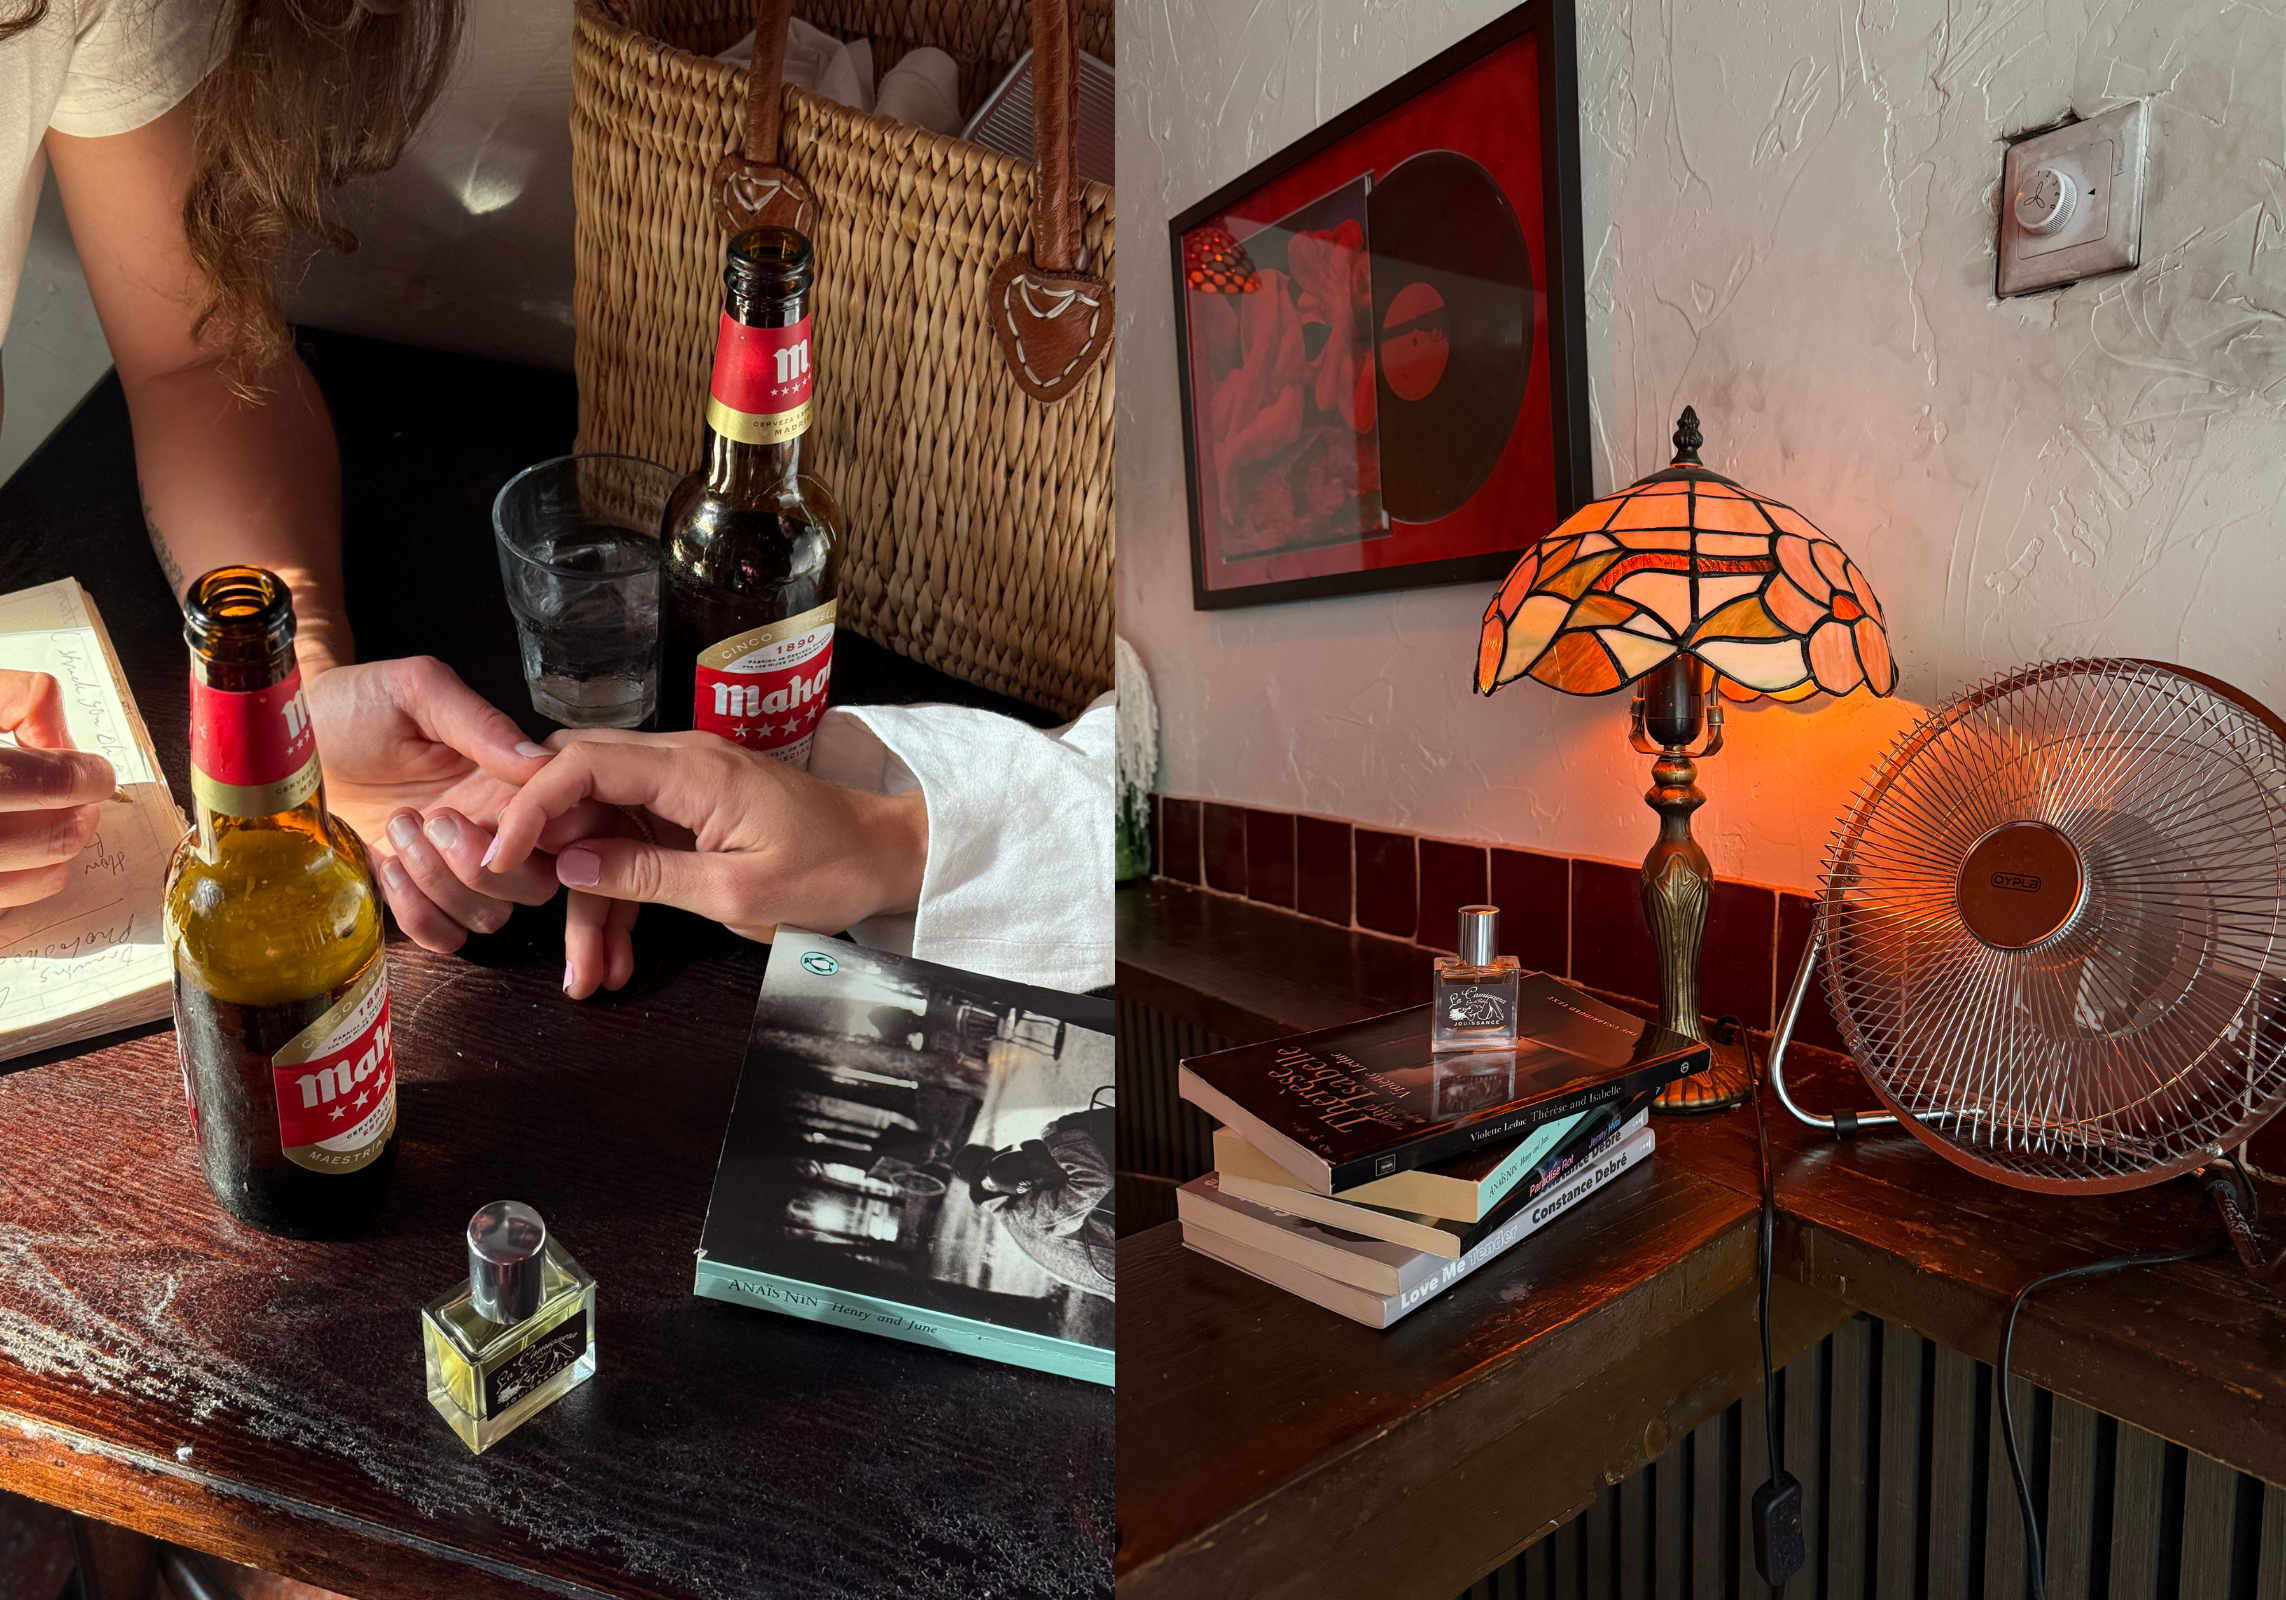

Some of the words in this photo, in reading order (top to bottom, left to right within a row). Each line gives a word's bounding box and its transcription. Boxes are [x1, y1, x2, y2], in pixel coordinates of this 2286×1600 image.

[753, 417, 794, 428] CERVEZA
[722, 633, 772, 660] CINCO
[776, 634, 815, 655] 1890
[1546, 996, 1569, 1008] TEXT
[302, 1001, 353, 1049] CINCO
[1454, 1019, 1500, 1027] JOUISSANCE
[1274, 1046, 1379, 1102] Isabelle
[1330, 1052, 1368, 1074] Leduc
[1268, 1067, 1376, 1134] Thérèse
[1365, 1072, 1412, 1099] Violette
[346, 1108, 382, 1140] CERVEZA
[1470, 1126, 1502, 1143] Violette
[1503, 1117, 1527, 1131] Leduc
[1530, 1103, 1568, 1122] Thérèse
[1569, 1094, 1587, 1110] and
[1588, 1084, 1622, 1103] Isabelle
[1529, 1166, 1561, 1198] Paradise
[1561, 1153, 1575, 1172] Rot
[1588, 1128, 1608, 1150] Jenny
[1608, 1115, 1622, 1134] Hval
[1400, 1276, 1439, 1310] Love
[1442, 1259, 1466, 1284] Me
[1468, 1224, 1518, 1266] Tender
[1532, 1177, 1593, 1224] Constance
[1595, 1151, 1628, 1185] Debré
[728, 1279, 780, 1299] ANAÏS
[831, 1302, 872, 1321] Henry
[877, 1314, 903, 1326] and
[904, 1320, 938, 1334] June
[504, 1360, 570, 1408] JOUISSANCE
